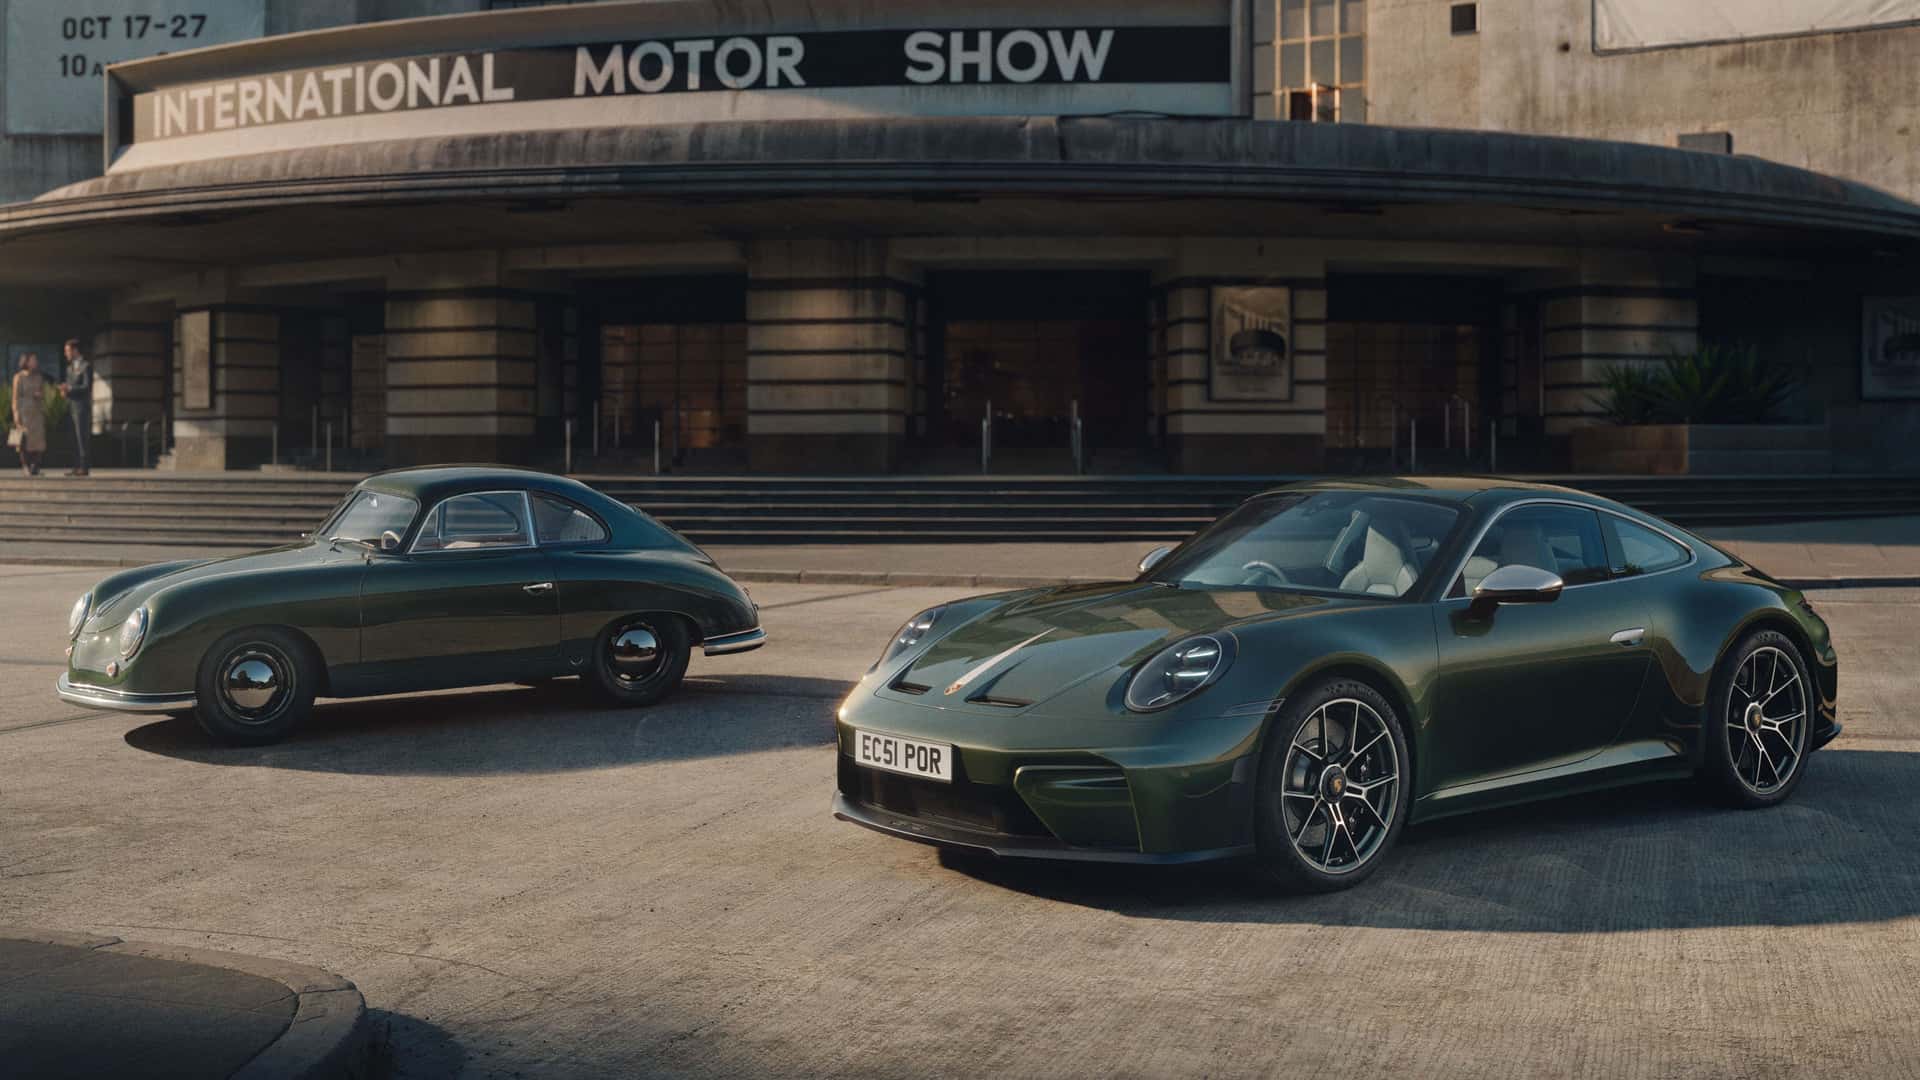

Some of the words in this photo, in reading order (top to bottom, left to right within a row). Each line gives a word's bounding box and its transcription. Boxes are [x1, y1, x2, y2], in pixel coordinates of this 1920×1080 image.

[63, 16, 111, 39] OCT
[124, 14, 207, 39] 17-27
[153, 53, 515, 137] INTERNATIONAL
[574, 36, 804, 96] MOTOR
[904, 29, 1115, 83] SHOW
[862, 734, 898, 767] EC51
[905, 743, 941, 774] POR
